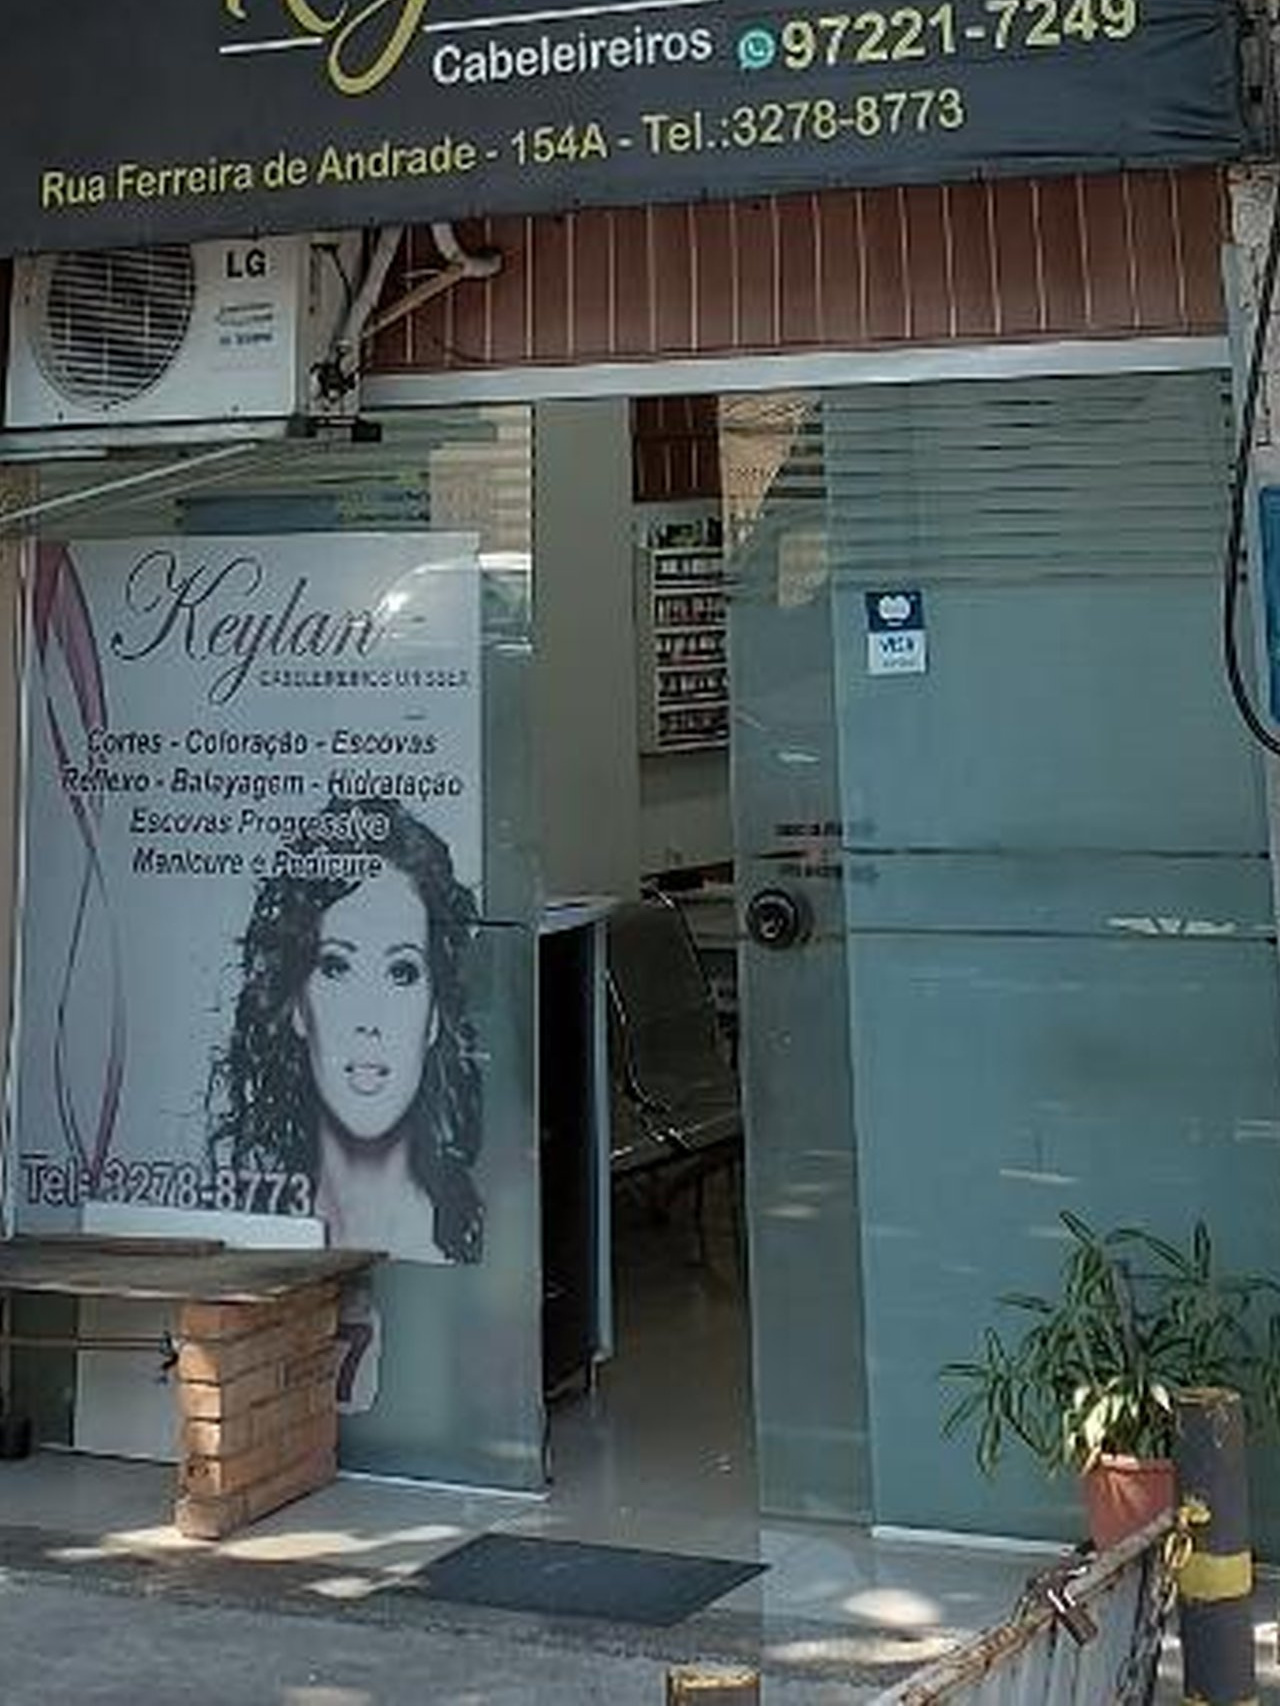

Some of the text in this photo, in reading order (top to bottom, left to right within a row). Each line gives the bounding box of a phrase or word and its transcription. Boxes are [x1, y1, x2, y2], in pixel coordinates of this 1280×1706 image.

[432, 25, 714, 84] Cabeleireiros
[42, 171, 106, 208] Rua
[117, 157, 252, 199] Ferreira
[262, 151, 308, 188] de
[318, 138, 477, 182] Andrade
[511, 123, 608, 165] 154A
[227, 248, 266, 278] LG
[110, 549, 379, 706] Keylan
[88, 729, 162, 755] Cortes
[186, 728, 307, 761] Coloração
[332, 729, 438, 755] Escovas
[63, 767, 150, 792] Reflexo
[171, 767, 304, 800] Balayagem
[328, 769, 464, 802] Hidratação
[130, 807, 233, 833] Escovas
[133, 847, 383, 878] Manicure e Pedicure
[103, 1162, 311, 1216] 3278-8773
